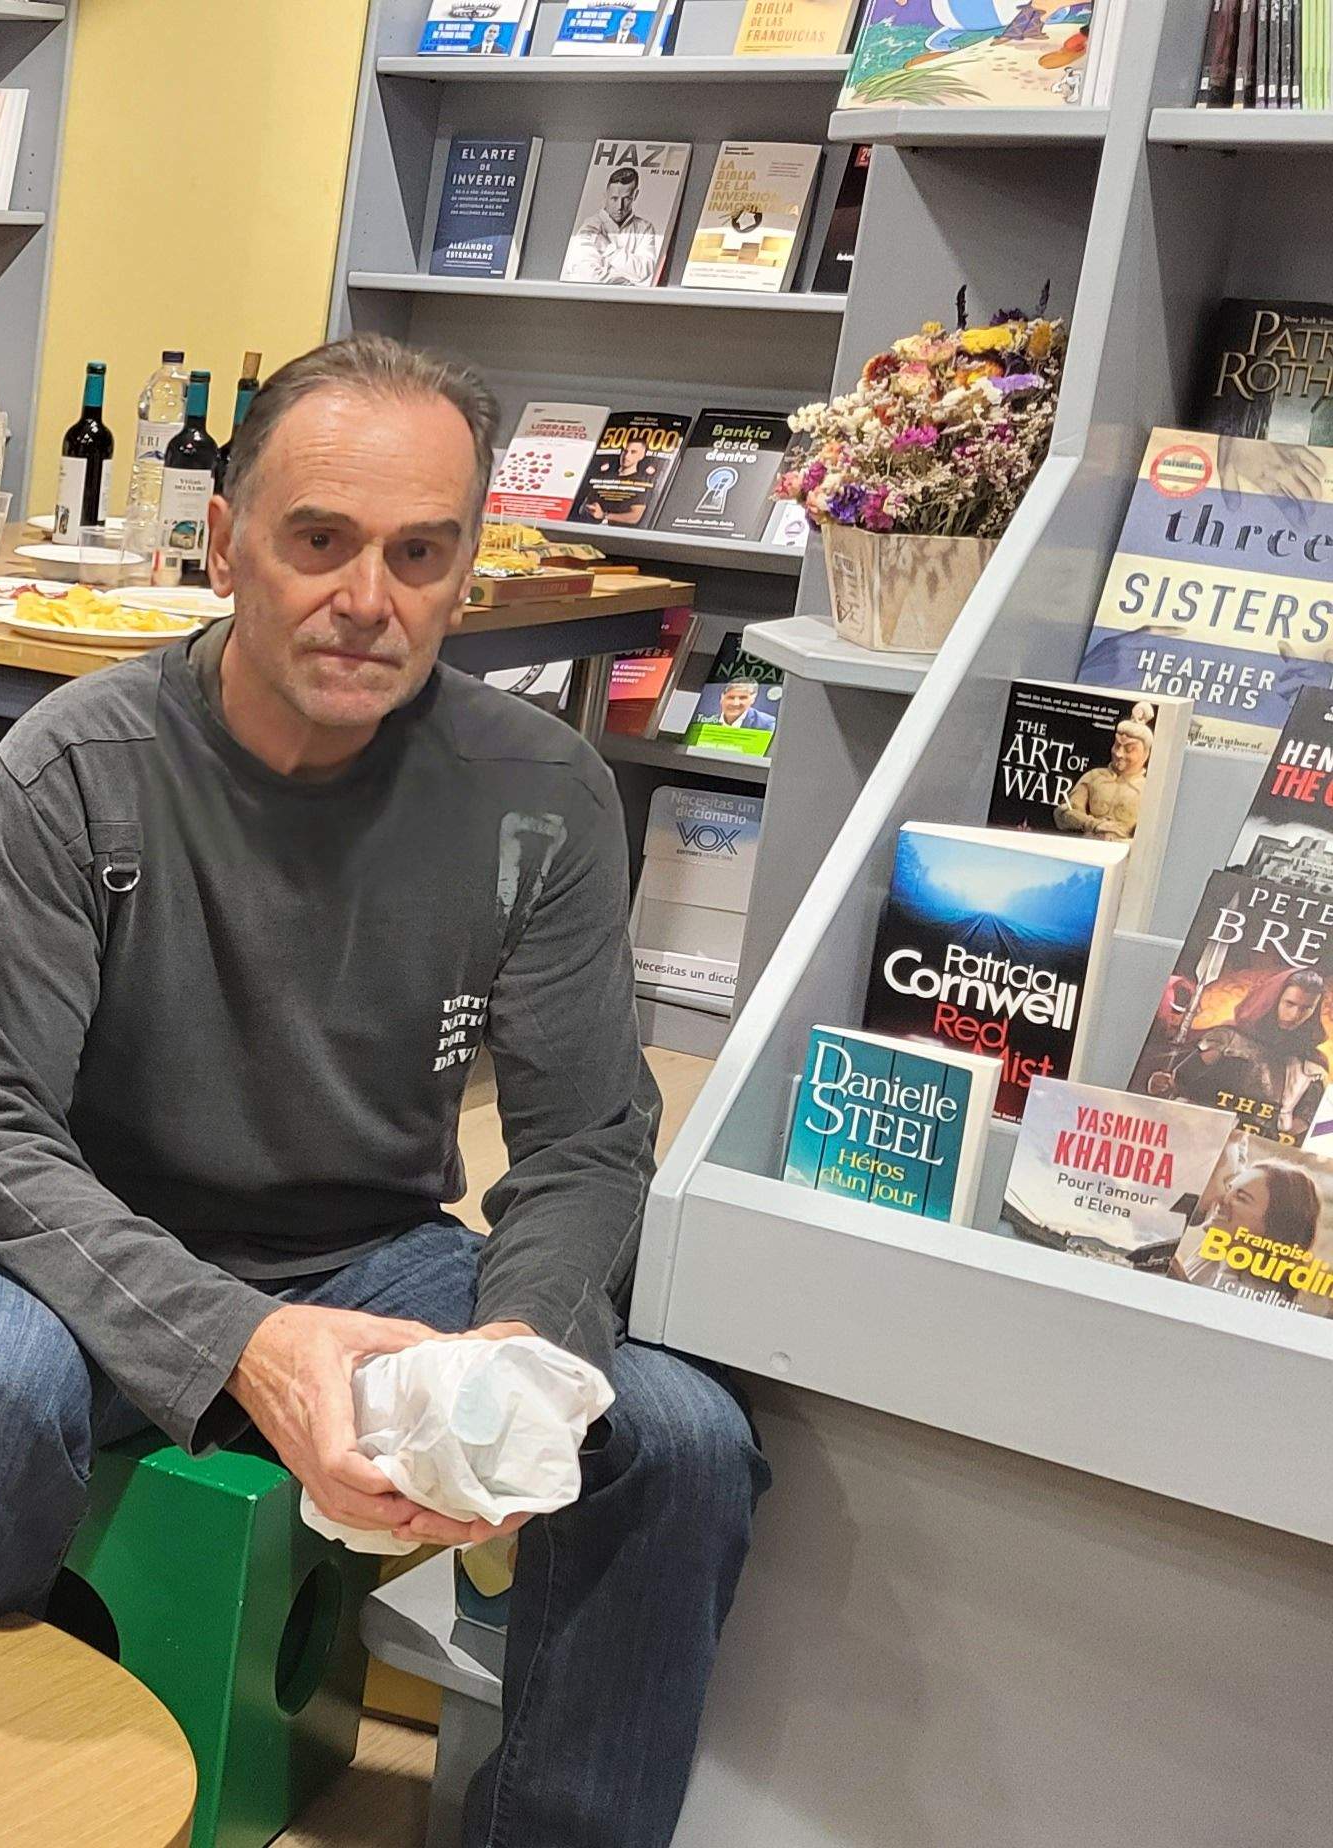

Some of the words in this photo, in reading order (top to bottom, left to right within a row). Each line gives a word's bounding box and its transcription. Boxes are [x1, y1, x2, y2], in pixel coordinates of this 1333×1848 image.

[746, 30, 827, 43] FRANQUICIAS
[461, 148, 476, 160] EL
[482, 149, 516, 161] ARTE
[479, 163, 491, 171] DE
[452, 174, 516, 187] INVERTIR
[717, 171, 757, 180] BIBLIA
[734, 181, 749, 190] LA
[712, 424, 772, 439] Bankia
[713, 437, 759, 451] desde
[705, 449, 757, 463] dentro
[1164, 504, 1333, 563] three
[1118, 572, 1333, 643] SISTERS
[1137, 649, 1276, 690] HEATHER
[1141, 672, 1260, 710] MORRIS
[1017, 719, 1047, 736] THE
[1002, 733, 1075, 774] ART
[1067, 754, 1090, 773] OF
[1002, 765, 1073, 811] WAR
[1270, 764, 1326, 803] THE
[671, 791, 733, 811] Necesitas
[738, 802, 756, 814] un
[676, 805, 747, 825] diccionario
[676, 822, 742, 855] VOX
[634, 958, 687, 977] Necesitas
[690, 969, 705, 981] un
[944, 943, 1058, 995] Patricia
[884, 949, 1078, 1031] Cornwell
[438, 1030, 466, 1051] FOR
[933, 1002, 1008, 1048] Red
[808, 1040, 958, 1123] Danielle
[1217, 1090, 1275, 1119] THE
[805, 1083, 944, 1166] STEEL
[1076, 1105, 1169, 1149] YASMINA
[837, 1148, 906, 1182] Héros
[1053, 1130, 1174, 1189] KHADRA
[870, 1176, 918, 1207] jour
[1057, 1172, 1095, 1192] Pour
[1097, 1181, 1159, 1205] l'amour
[1074, 1195, 1131, 1218] d'Elena
[1233, 1225, 1315, 1263] Françoise
[1212, 1272, 1235, 1294] Le
[1237, 1282, 1303, 1313] meilleur
